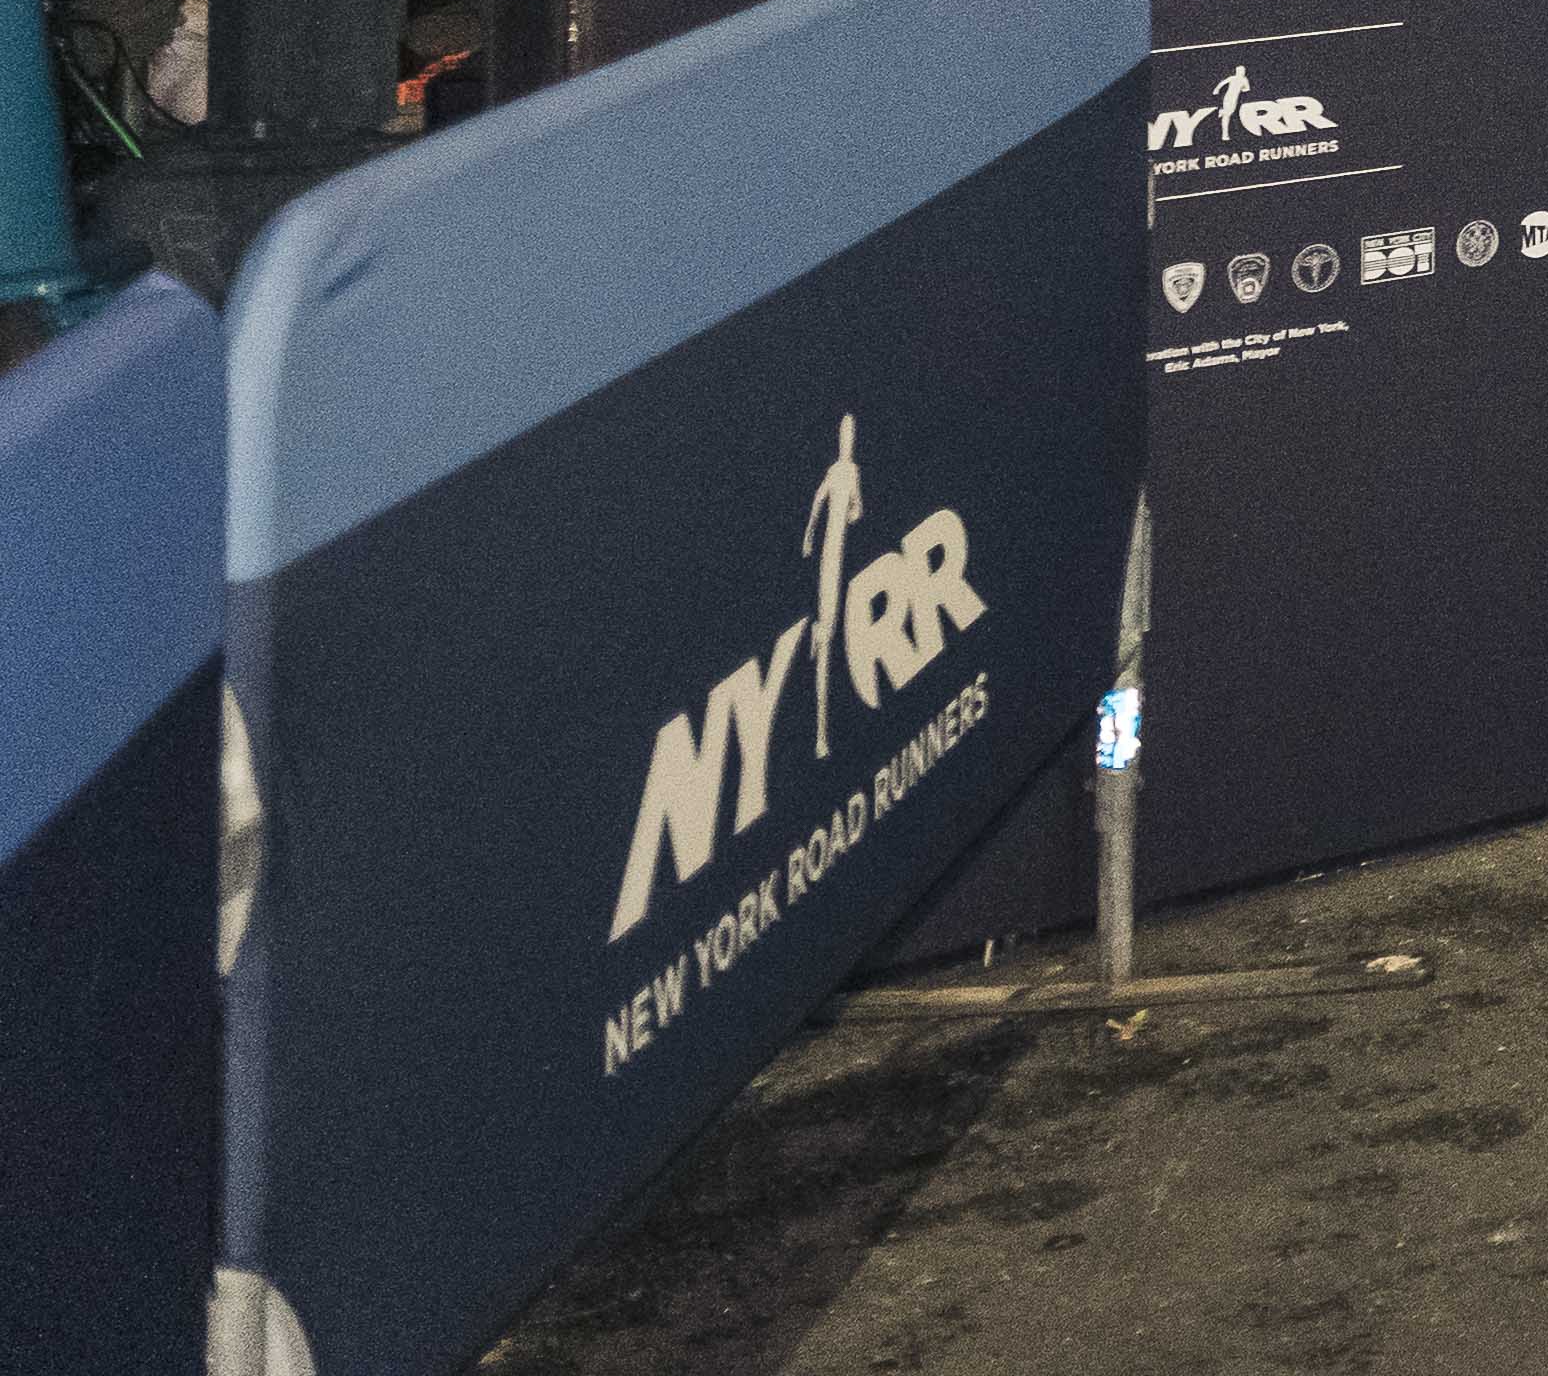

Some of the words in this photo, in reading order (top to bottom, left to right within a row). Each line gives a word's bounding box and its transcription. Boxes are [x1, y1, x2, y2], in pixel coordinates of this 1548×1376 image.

[1152, 157, 1201, 176] YORK
[1204, 151, 1255, 169] ROAD
[1258, 139, 1340, 162] RUNNERS
[602, 953, 689, 1077] NEW
[693, 871, 783, 988] YORK
[786, 792, 867, 906] ROAD
[873, 671, 990, 821] RUNNERS
